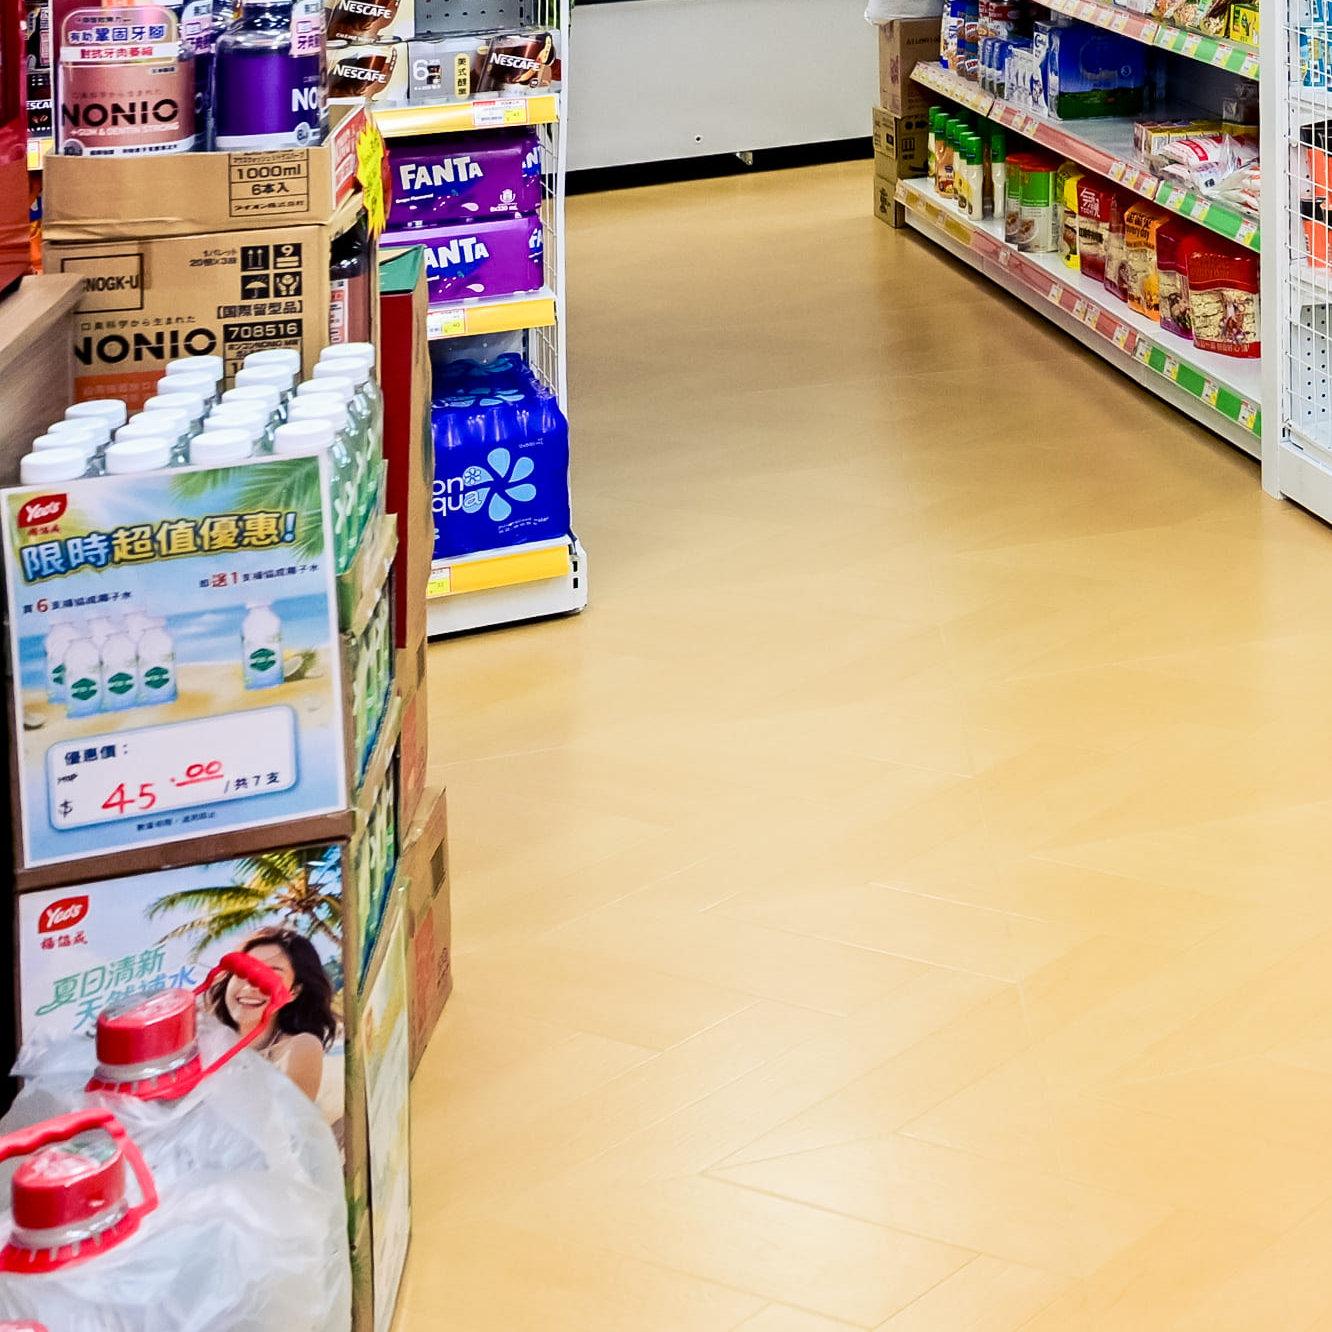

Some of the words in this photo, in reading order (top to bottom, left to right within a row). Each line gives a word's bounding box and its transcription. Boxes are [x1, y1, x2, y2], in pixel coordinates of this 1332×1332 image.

[62, 99, 179, 127] NONIO
[237, 165, 301, 180] 1000ml
[400, 157, 483, 190] FANTA
[251, 183, 289, 195] 6本入
[228, 322, 298, 339] 708516
[75, 328, 217, 365] NONIO
[21, 512, 297, 582] 限時超值優惠!
[101, 783, 156, 814] 45
